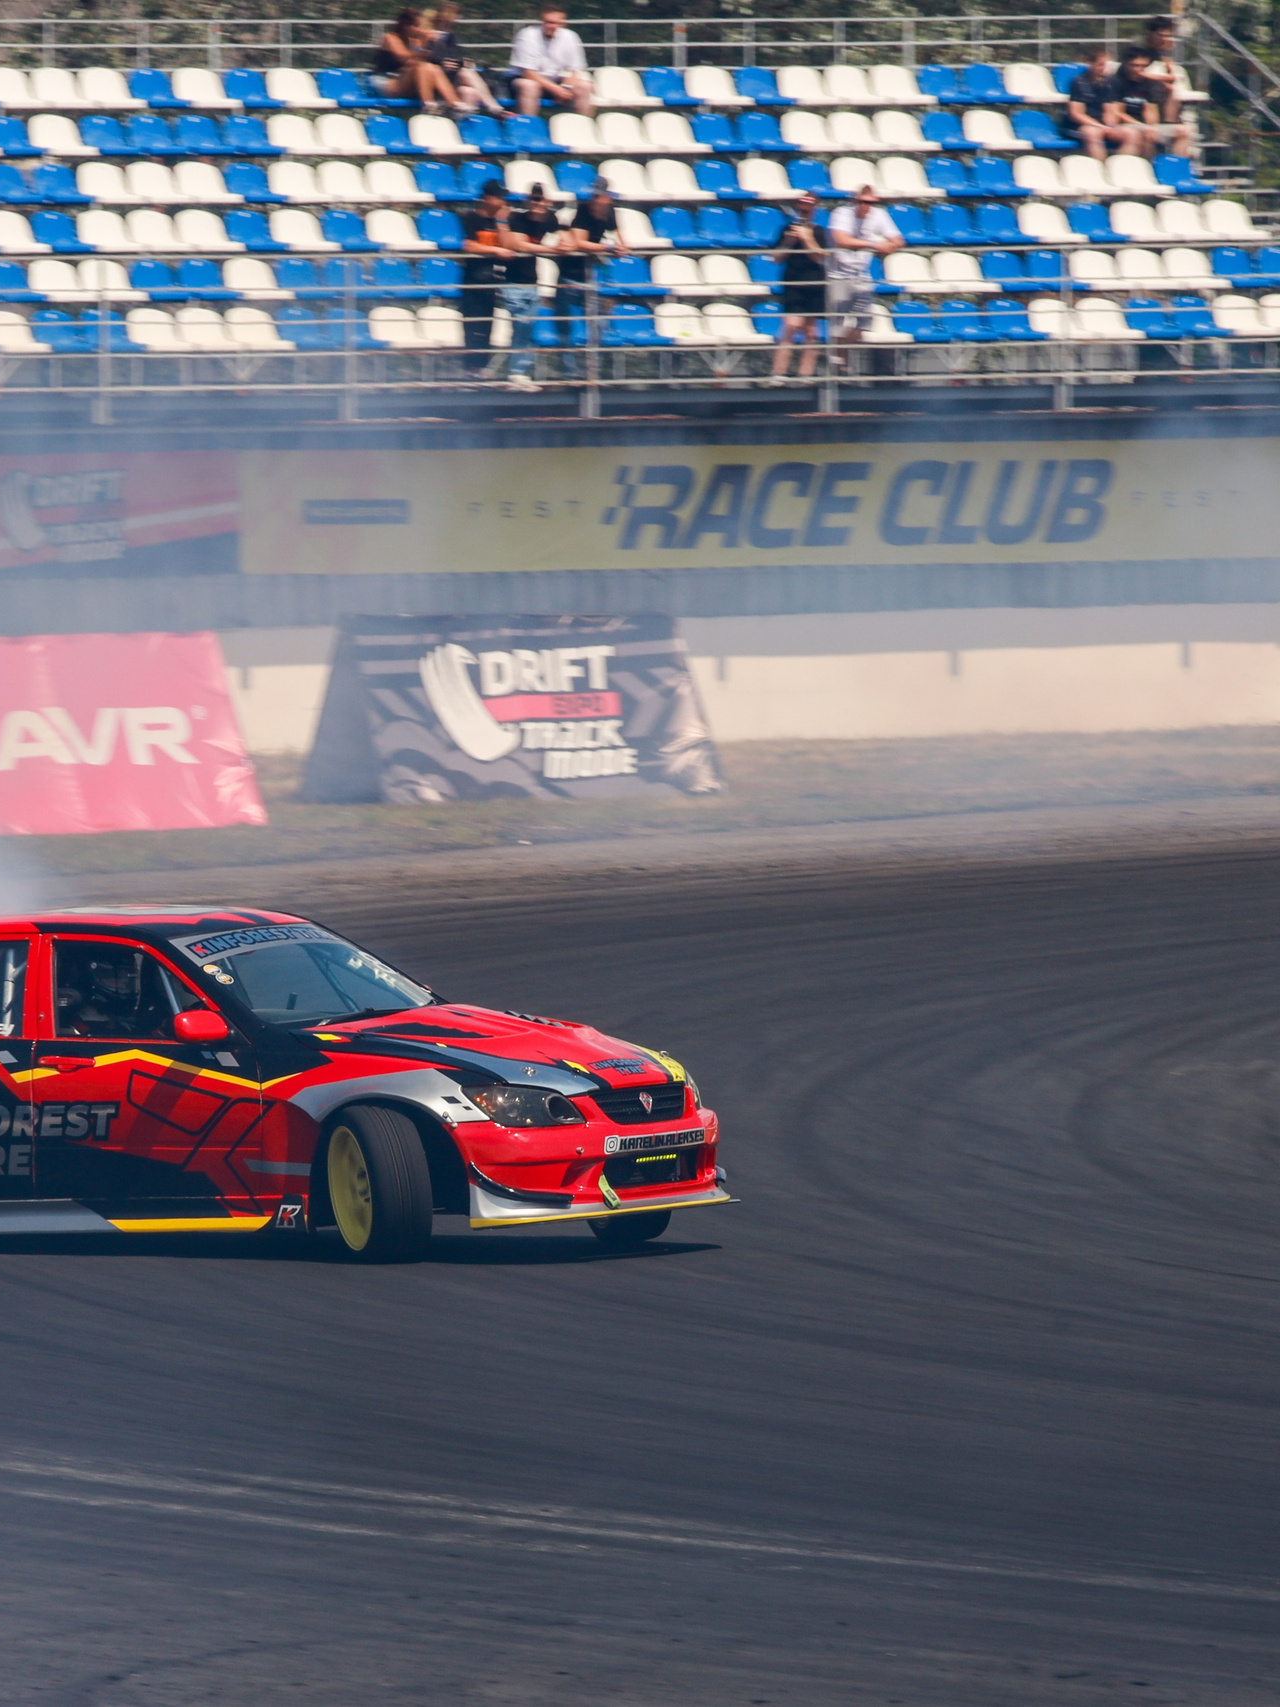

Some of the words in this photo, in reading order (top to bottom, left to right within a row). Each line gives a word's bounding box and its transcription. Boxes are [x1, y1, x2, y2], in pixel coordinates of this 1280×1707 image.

[606, 461, 872, 550] RACE
[879, 459, 1114, 547] CLUB
[478, 645, 617, 696] DRIFT
[188, 927, 297, 958] KINFOREST
